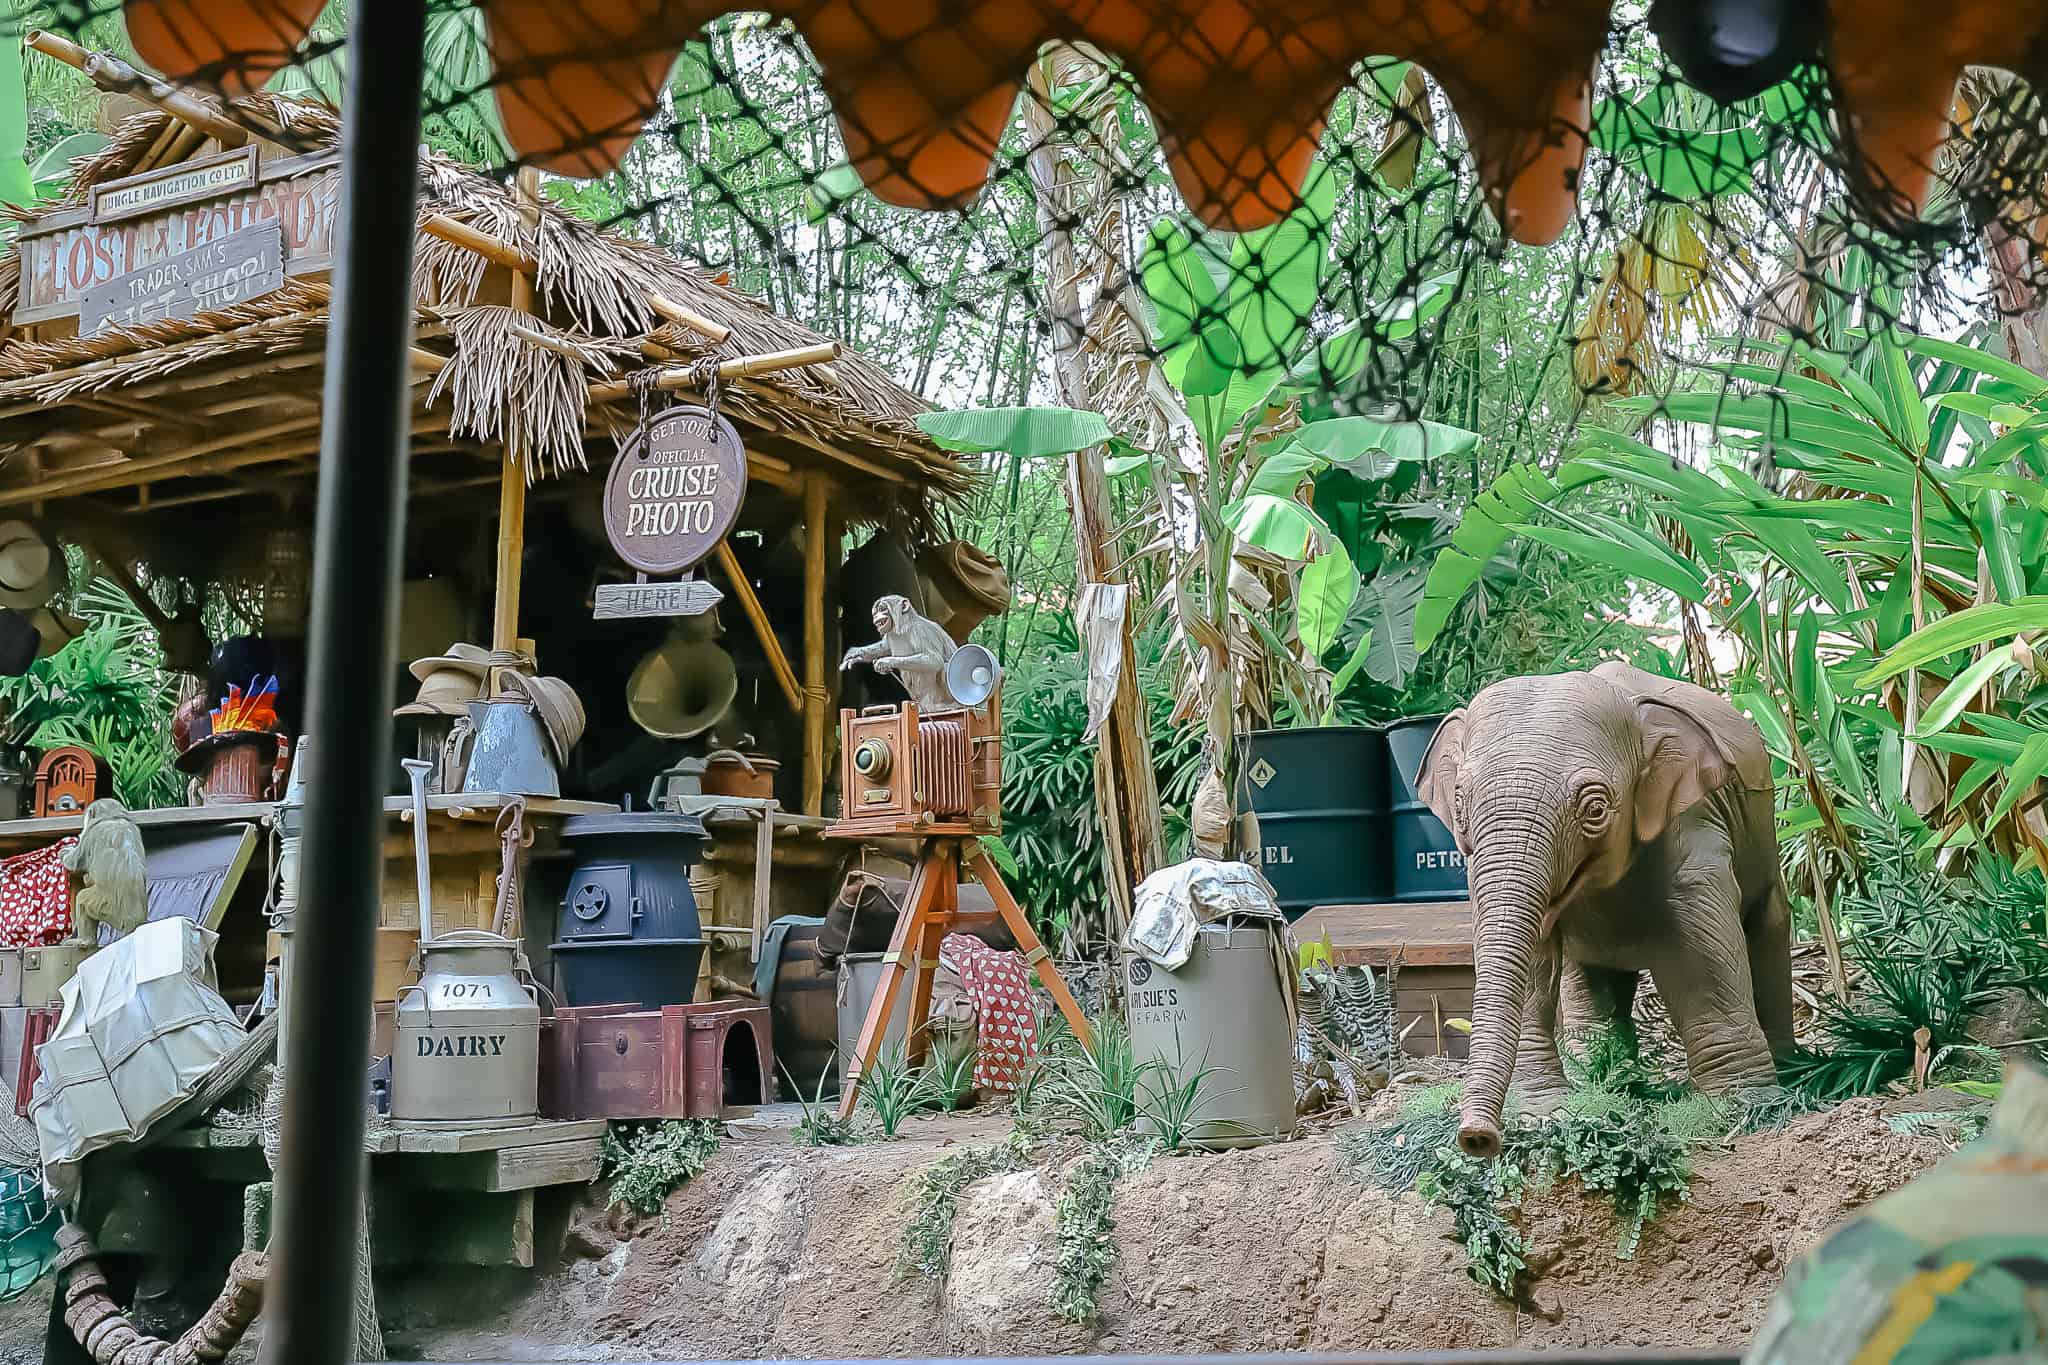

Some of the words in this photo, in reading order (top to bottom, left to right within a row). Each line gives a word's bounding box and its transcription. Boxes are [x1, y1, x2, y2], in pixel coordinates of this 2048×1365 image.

[102, 190, 140, 210] JUNGLE
[143, 174, 206, 201] NAVIGATION
[128, 264, 182, 299] TRADER
[185, 242, 226, 276] SAM'S
[190, 250, 266, 310] SHOP!
[650, 421, 677, 441] GET
[653, 448, 706, 464] OFFICIAL
[627, 463, 720, 499] CRUISE
[625, 500, 714, 537] PHOTO
[626, 586, 691, 610] HERE!
[442, 983, 491, 998] 1071
[1143, 989, 1177, 1008] SUE'S
[1145, 1009, 1187, 1025] FARM
[417, 1035, 506, 1057] DAIRY
